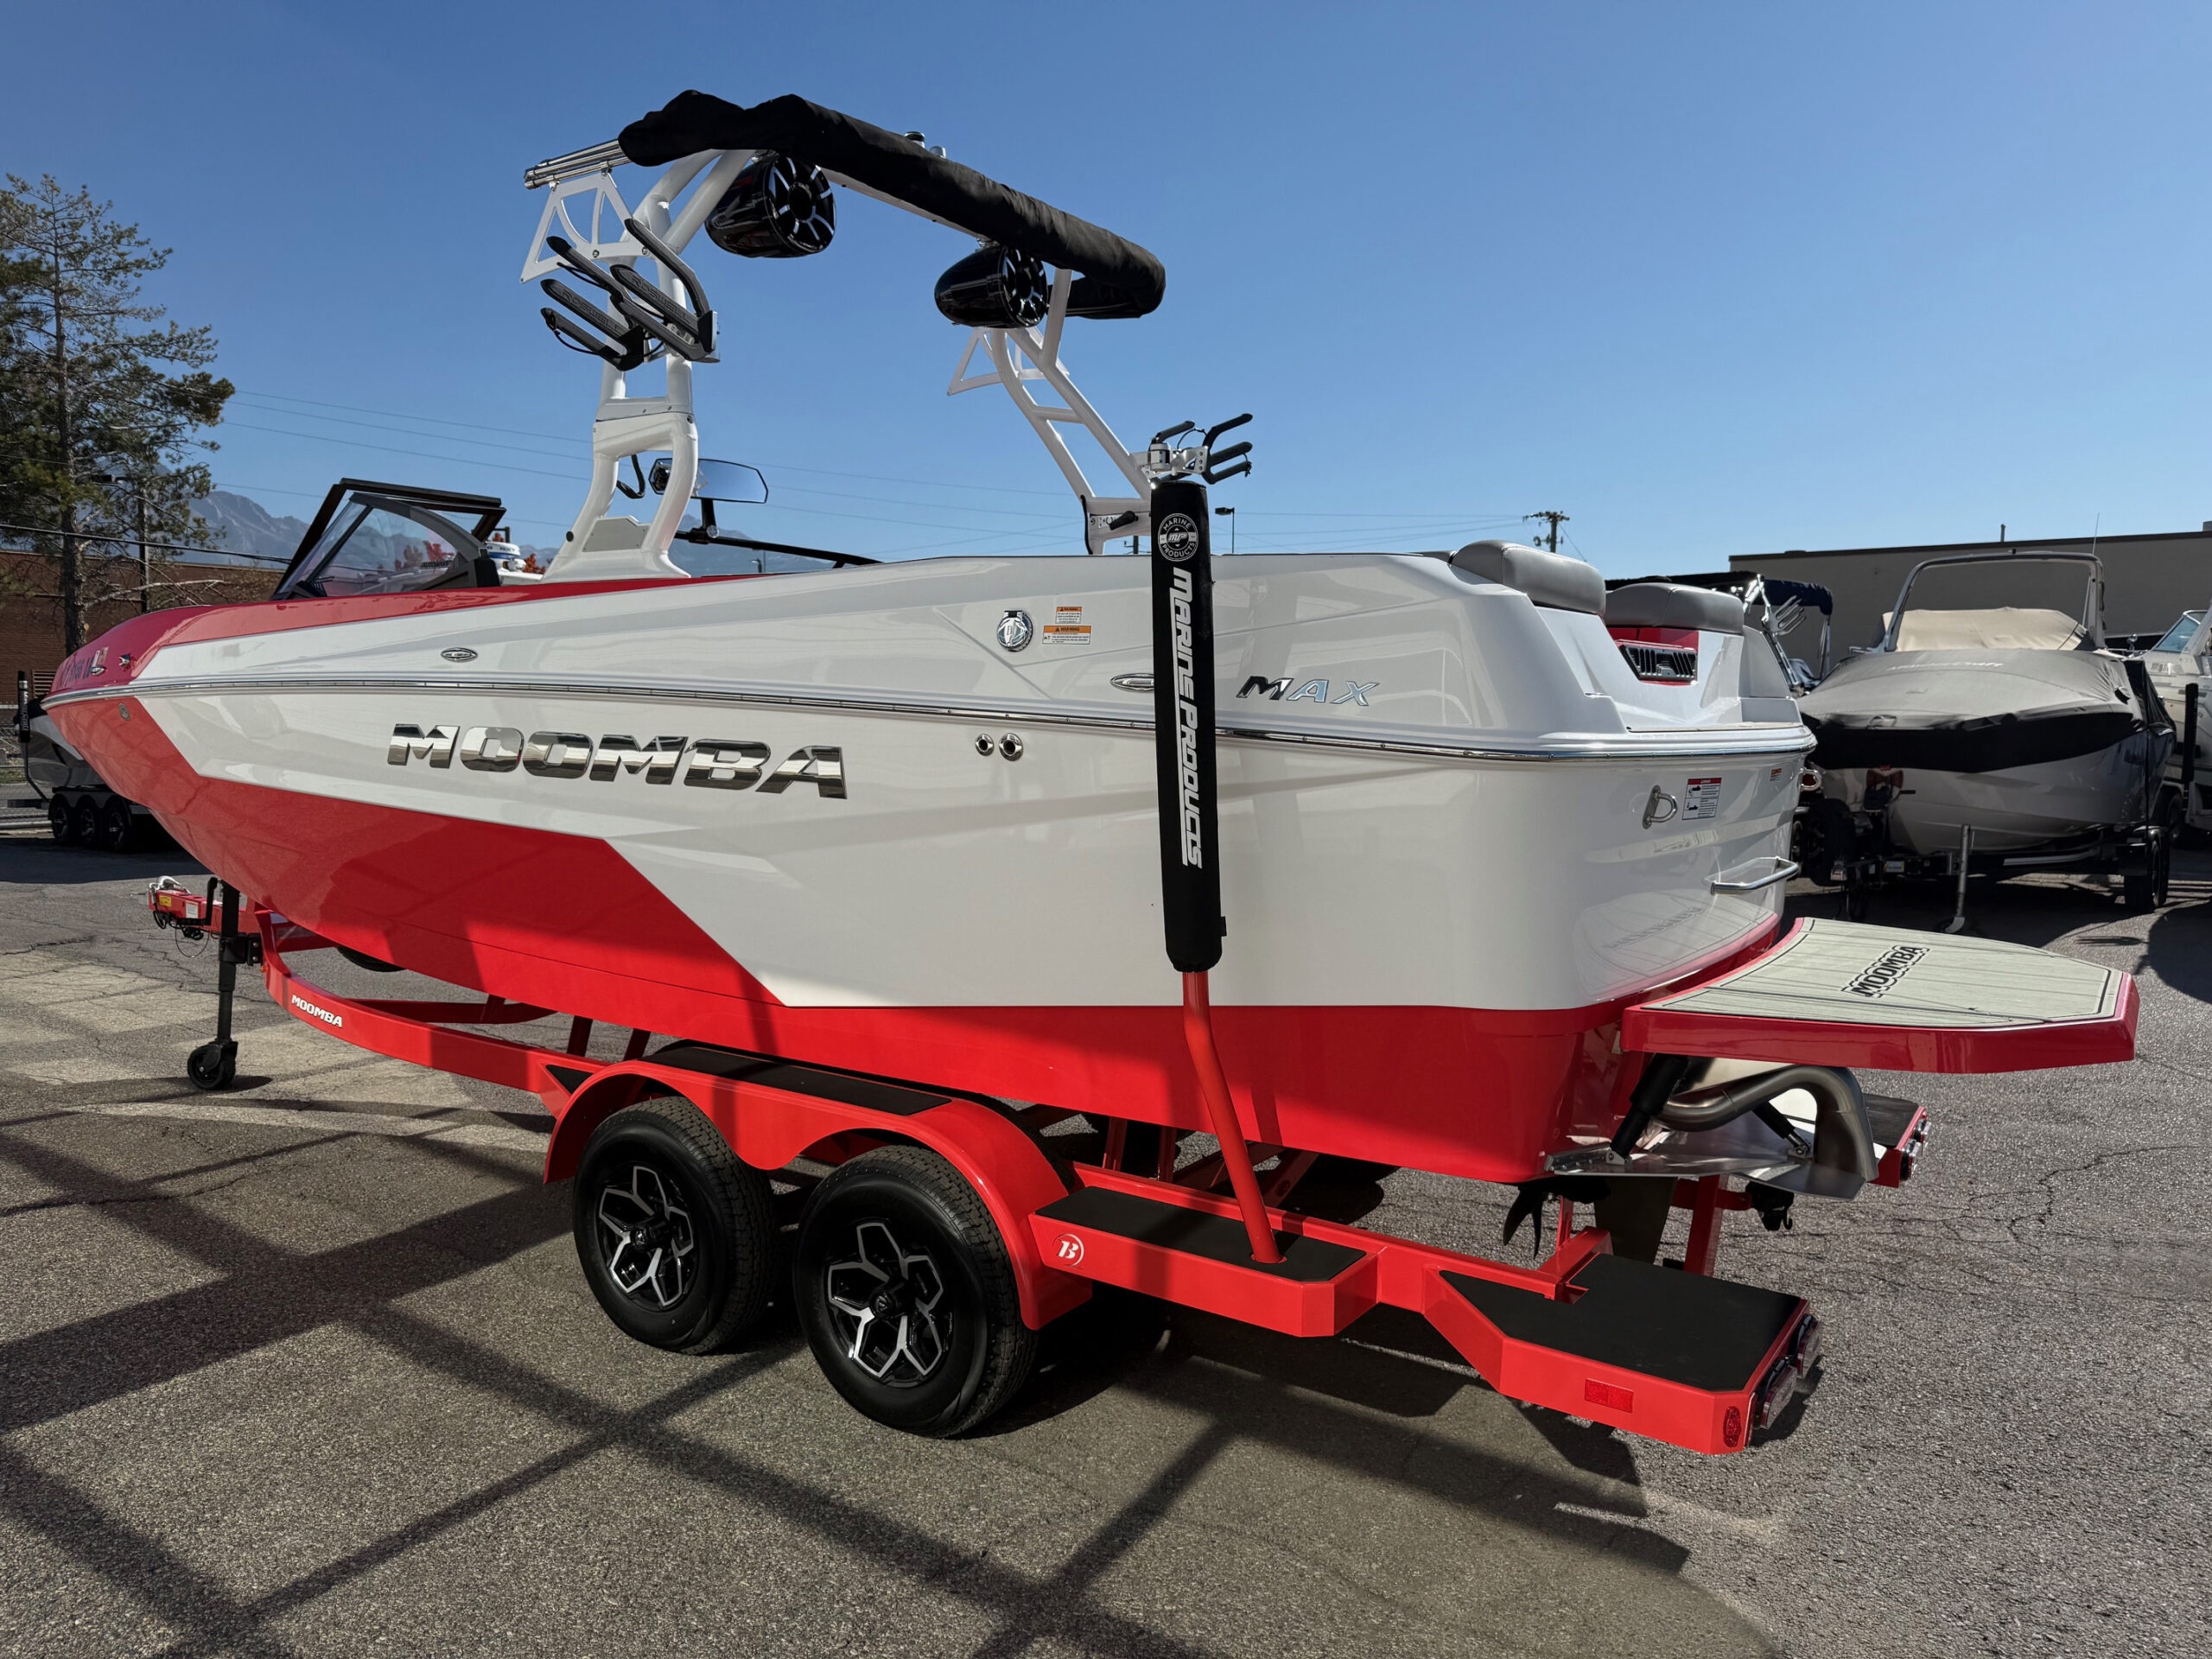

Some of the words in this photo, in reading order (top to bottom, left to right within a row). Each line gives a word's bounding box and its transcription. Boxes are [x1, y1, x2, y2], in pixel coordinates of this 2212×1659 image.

[1162, 518, 1192, 531] MARINE
[1162, 542, 1195, 557] PRODUCTS
[1170, 567, 1194, 700] MARINE
[1236, 676, 1380, 706] MAX
[387, 722, 848, 799] MOOMBA
[1179, 699, 1203, 869] PRODUCTS
[1850, 945, 1923, 998] MOOMBA
[291, 994, 343, 1027] MOOMBA
